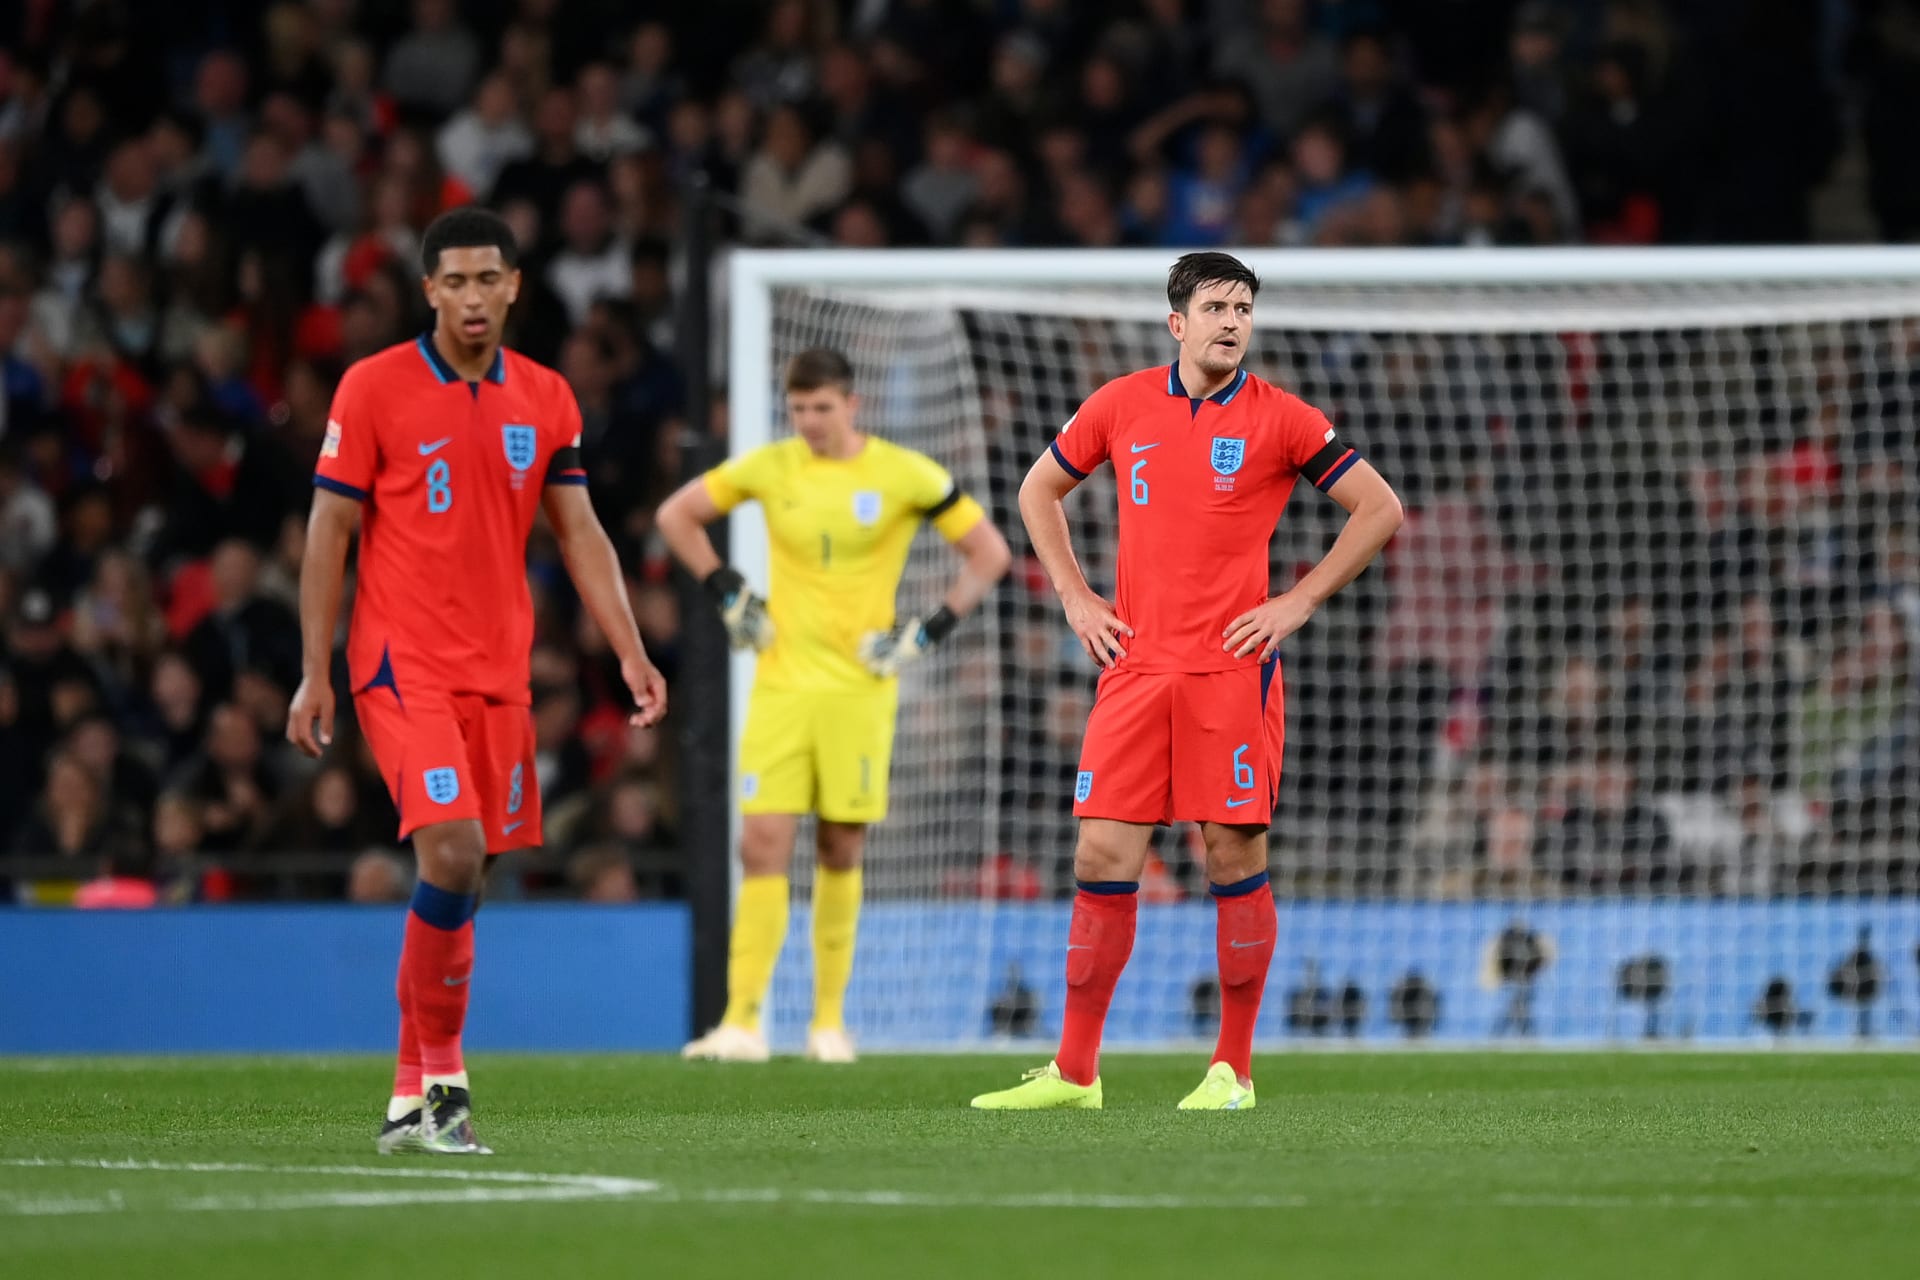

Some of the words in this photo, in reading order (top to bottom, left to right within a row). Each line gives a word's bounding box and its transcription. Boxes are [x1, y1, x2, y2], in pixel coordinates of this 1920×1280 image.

[426, 458, 452, 513] 8
[1131, 459, 1149, 505] 6
[507, 761, 523, 815] 8
[1233, 744, 1255, 789] 6
